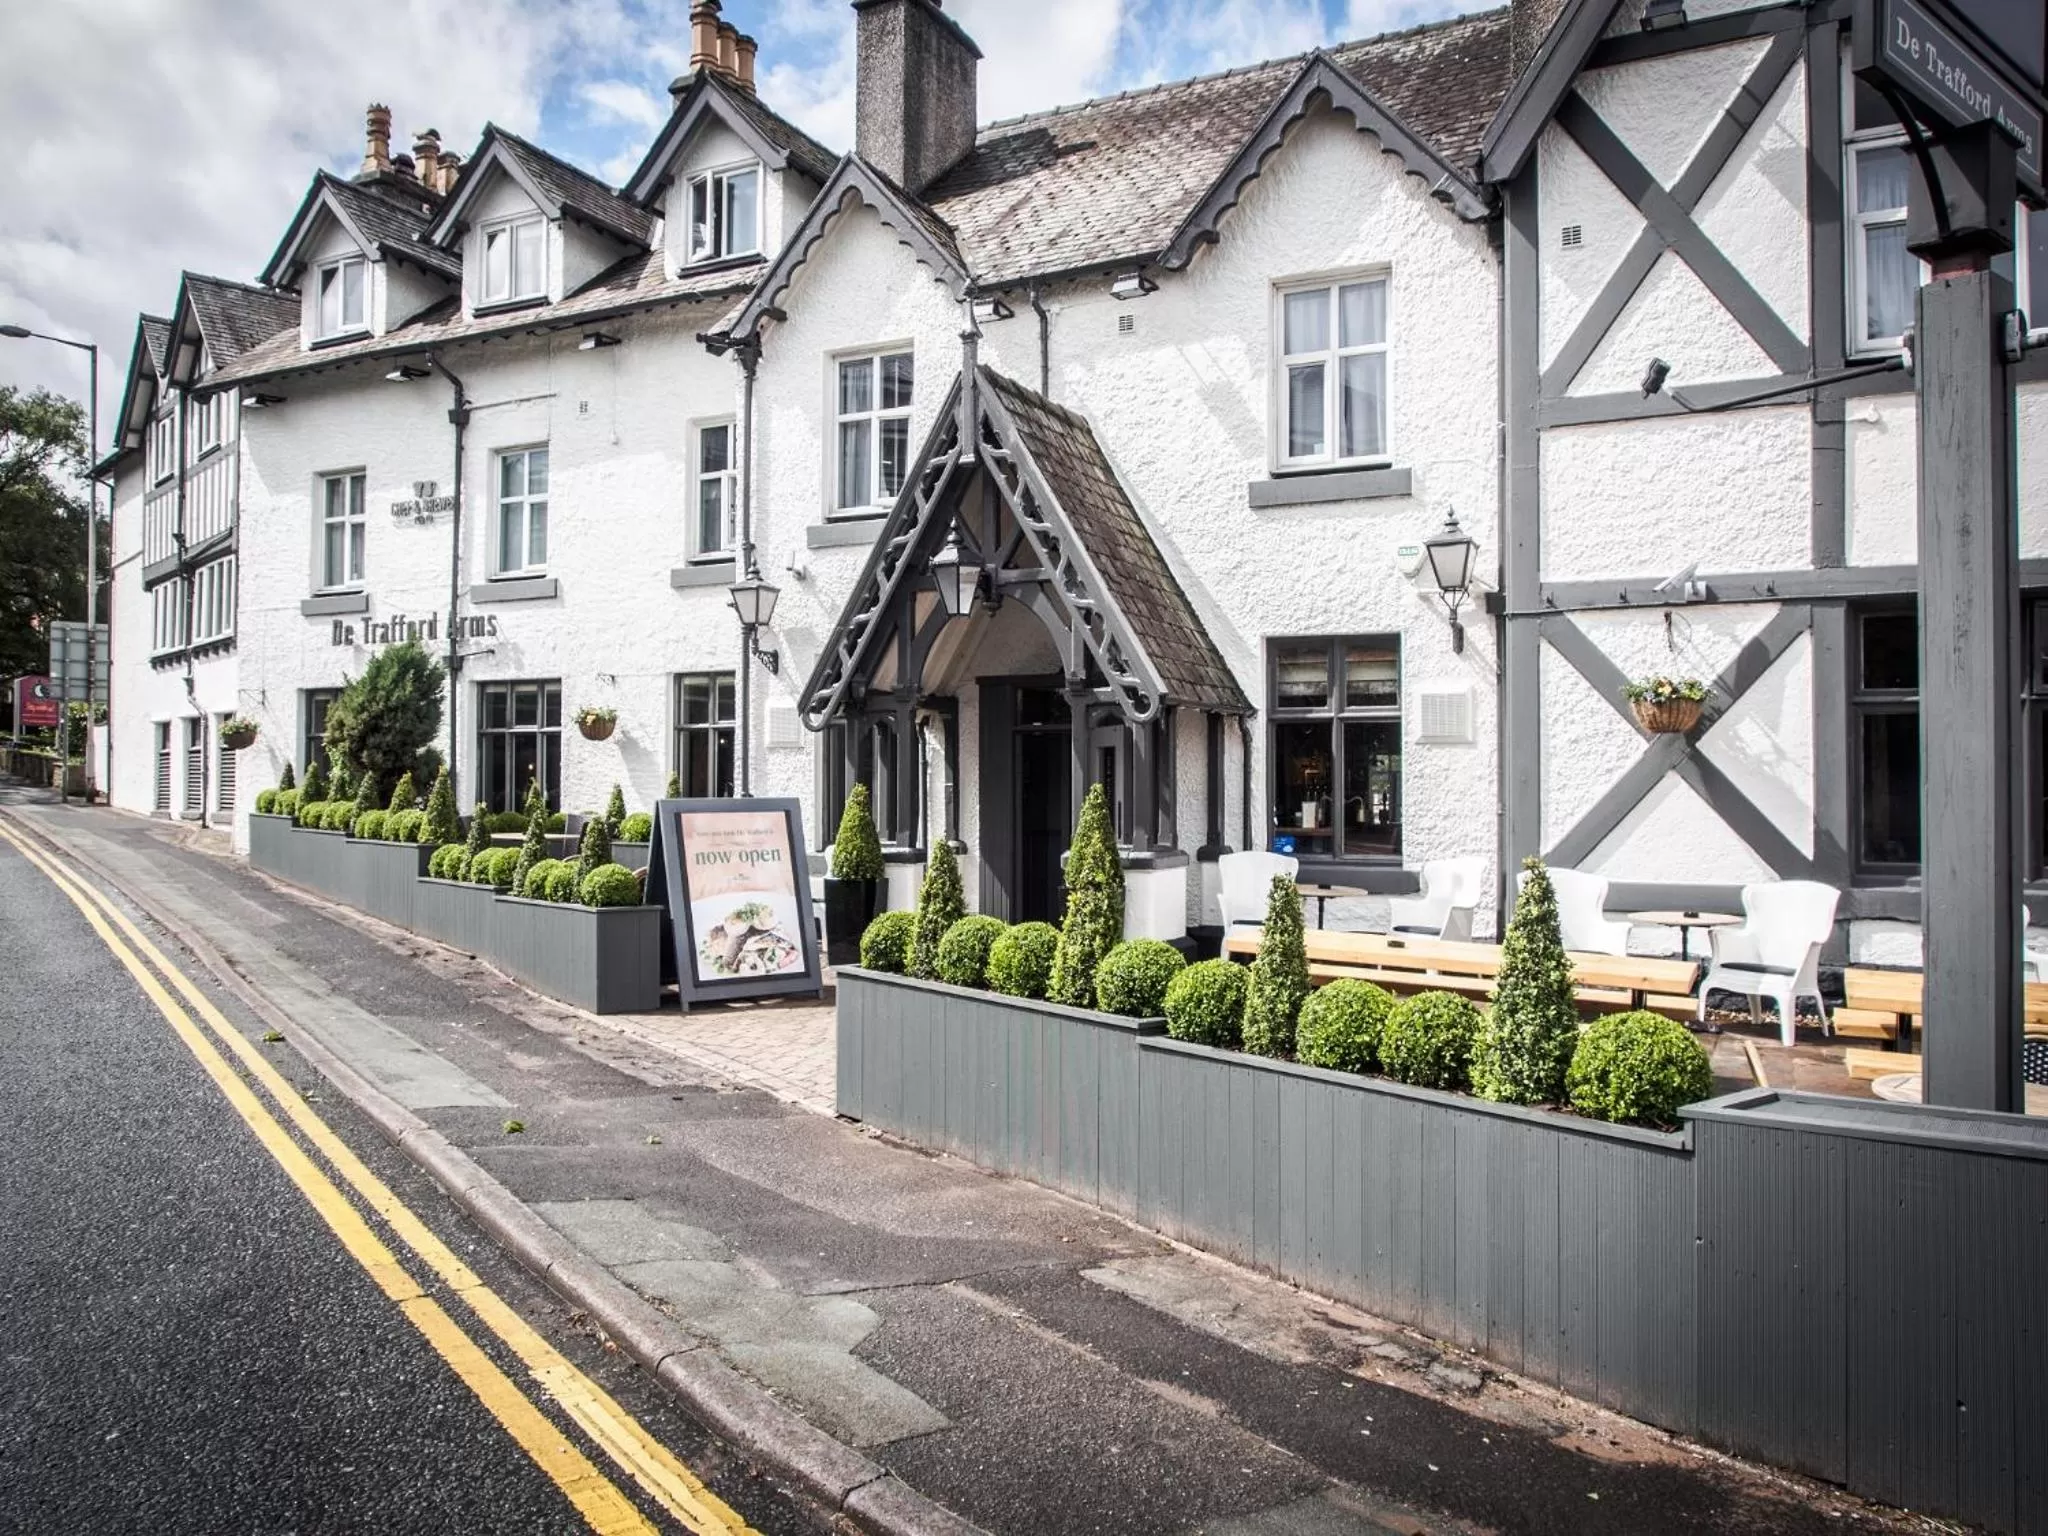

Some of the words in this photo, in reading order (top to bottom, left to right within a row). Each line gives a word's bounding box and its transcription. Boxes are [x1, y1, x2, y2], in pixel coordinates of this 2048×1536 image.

[1896, 16, 1920, 59] De
[1925, 41, 1992, 119] Trafford
[332, 619, 354, 646] De
[361, 611, 438, 644] Trafford
[695, 850, 732, 865] now
[738, 848, 781, 868] open
